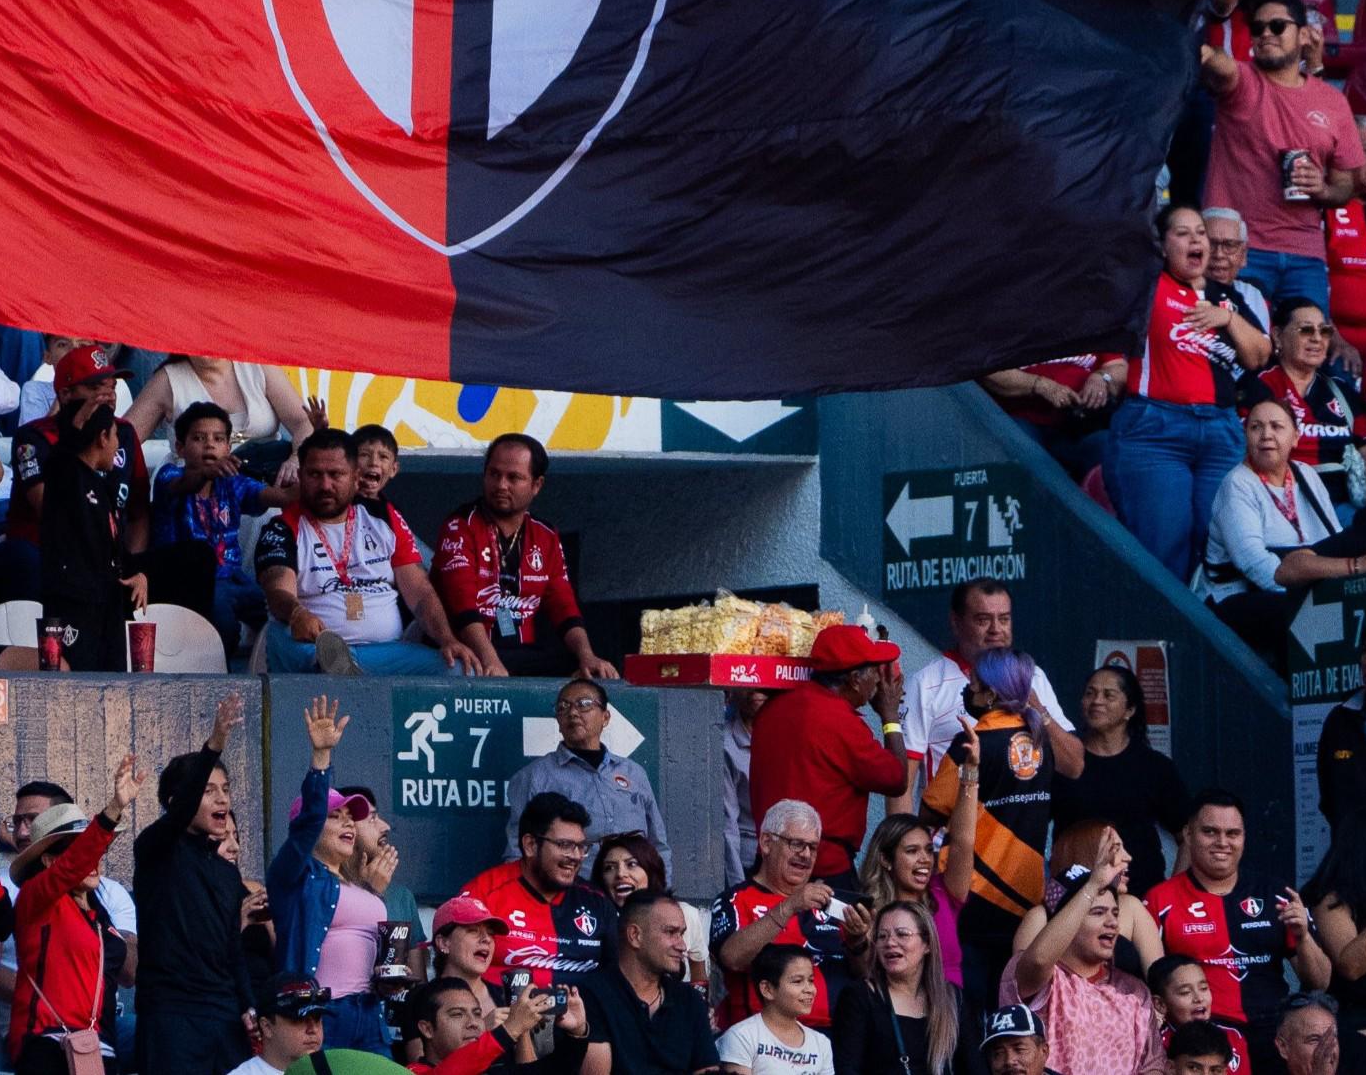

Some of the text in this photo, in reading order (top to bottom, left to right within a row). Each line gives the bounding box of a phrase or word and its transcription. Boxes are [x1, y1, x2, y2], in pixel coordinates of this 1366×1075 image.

[954, 470, 989, 487] PUERTA
[964, 501, 979, 542] 7
[887, 548, 1025, 590] RUTA DE EVACUACIÓN
[1354, 610, 1366, 648] 7
[1292, 669, 1322, 699] RUTA
[1324, 667, 1342, 693] DE
[454, 698, 512, 715] PUERTA
[469, 727, 492, 768] 7
[401, 779, 462, 808] RUTA
[467, 780, 497, 808] DE
[504, 946, 600, 973] Caliente
[991, 1012, 1016, 1030] LA
